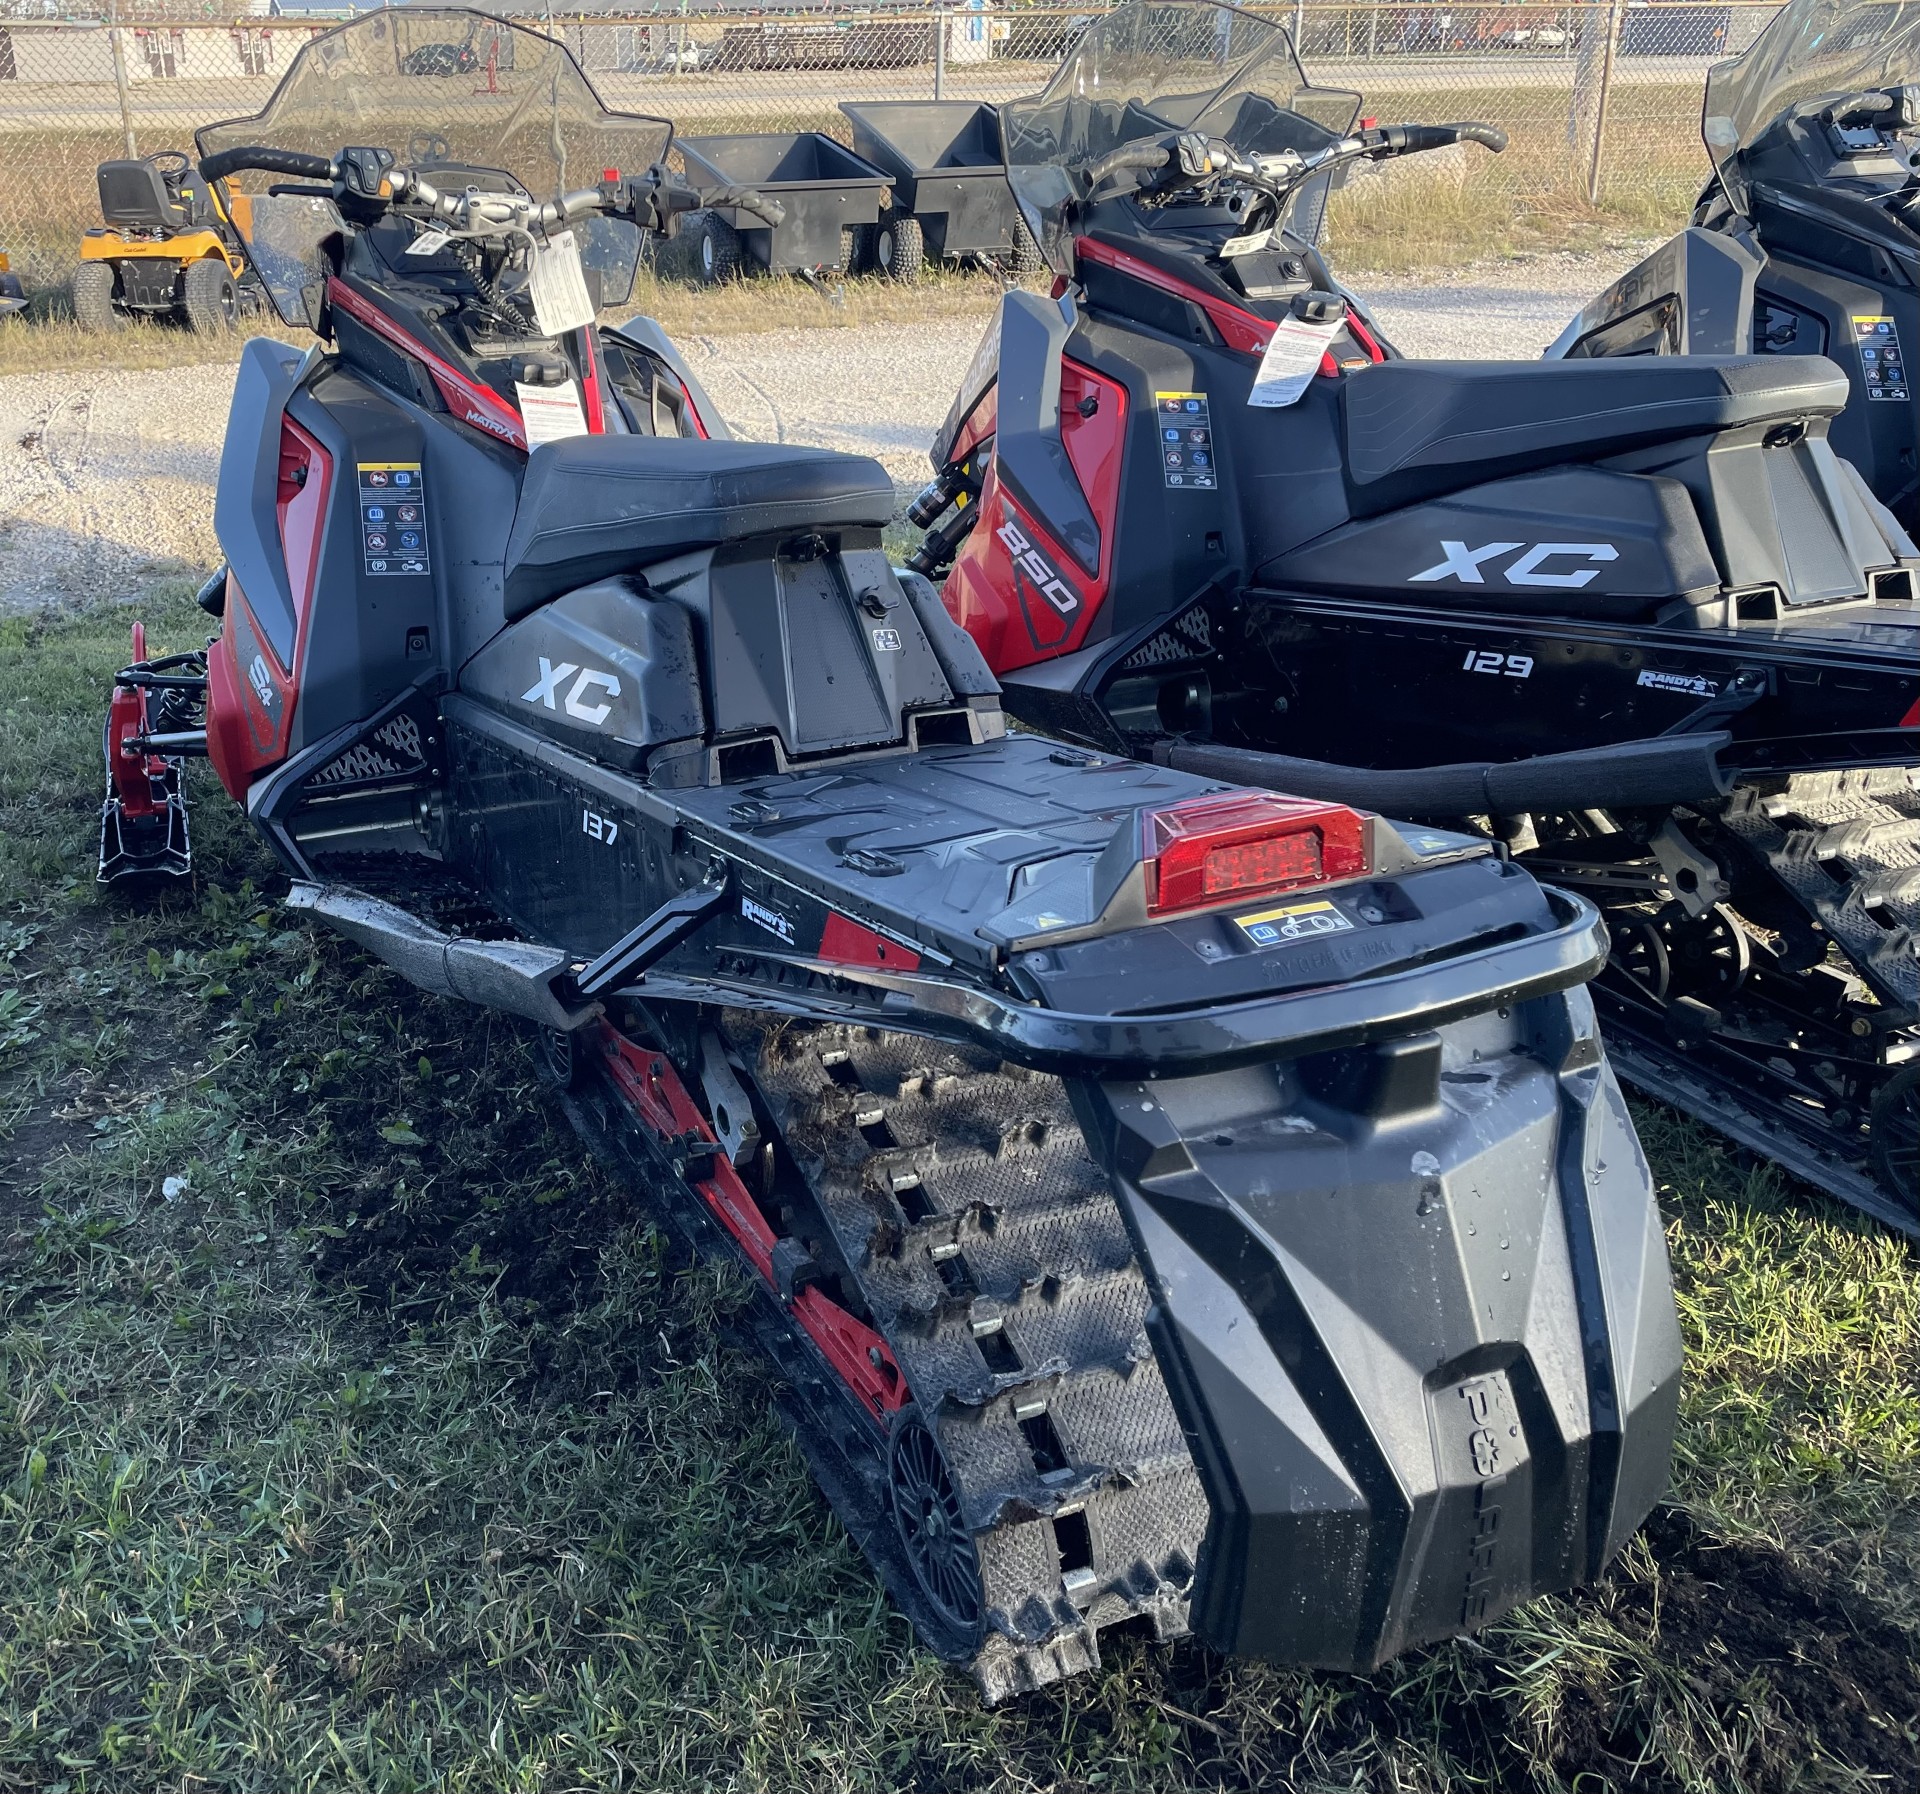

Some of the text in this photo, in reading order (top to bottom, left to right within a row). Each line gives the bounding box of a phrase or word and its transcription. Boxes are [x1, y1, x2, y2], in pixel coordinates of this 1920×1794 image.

[466, 409, 517, 443] MATRYX
[996, 521, 1078, 613] 850
[1407, 540, 1620, 588] XC
[250, 654, 273, 707] S4
[1462, 650, 1535, 679] 129
[1636, 671, 1707, 691] RANDY'S
[520, 656, 622, 726] XC
[582, 809, 618, 846] 137
[741, 897, 787, 935] RANDY'S
[1360, 938, 1397, 959] TRACK
